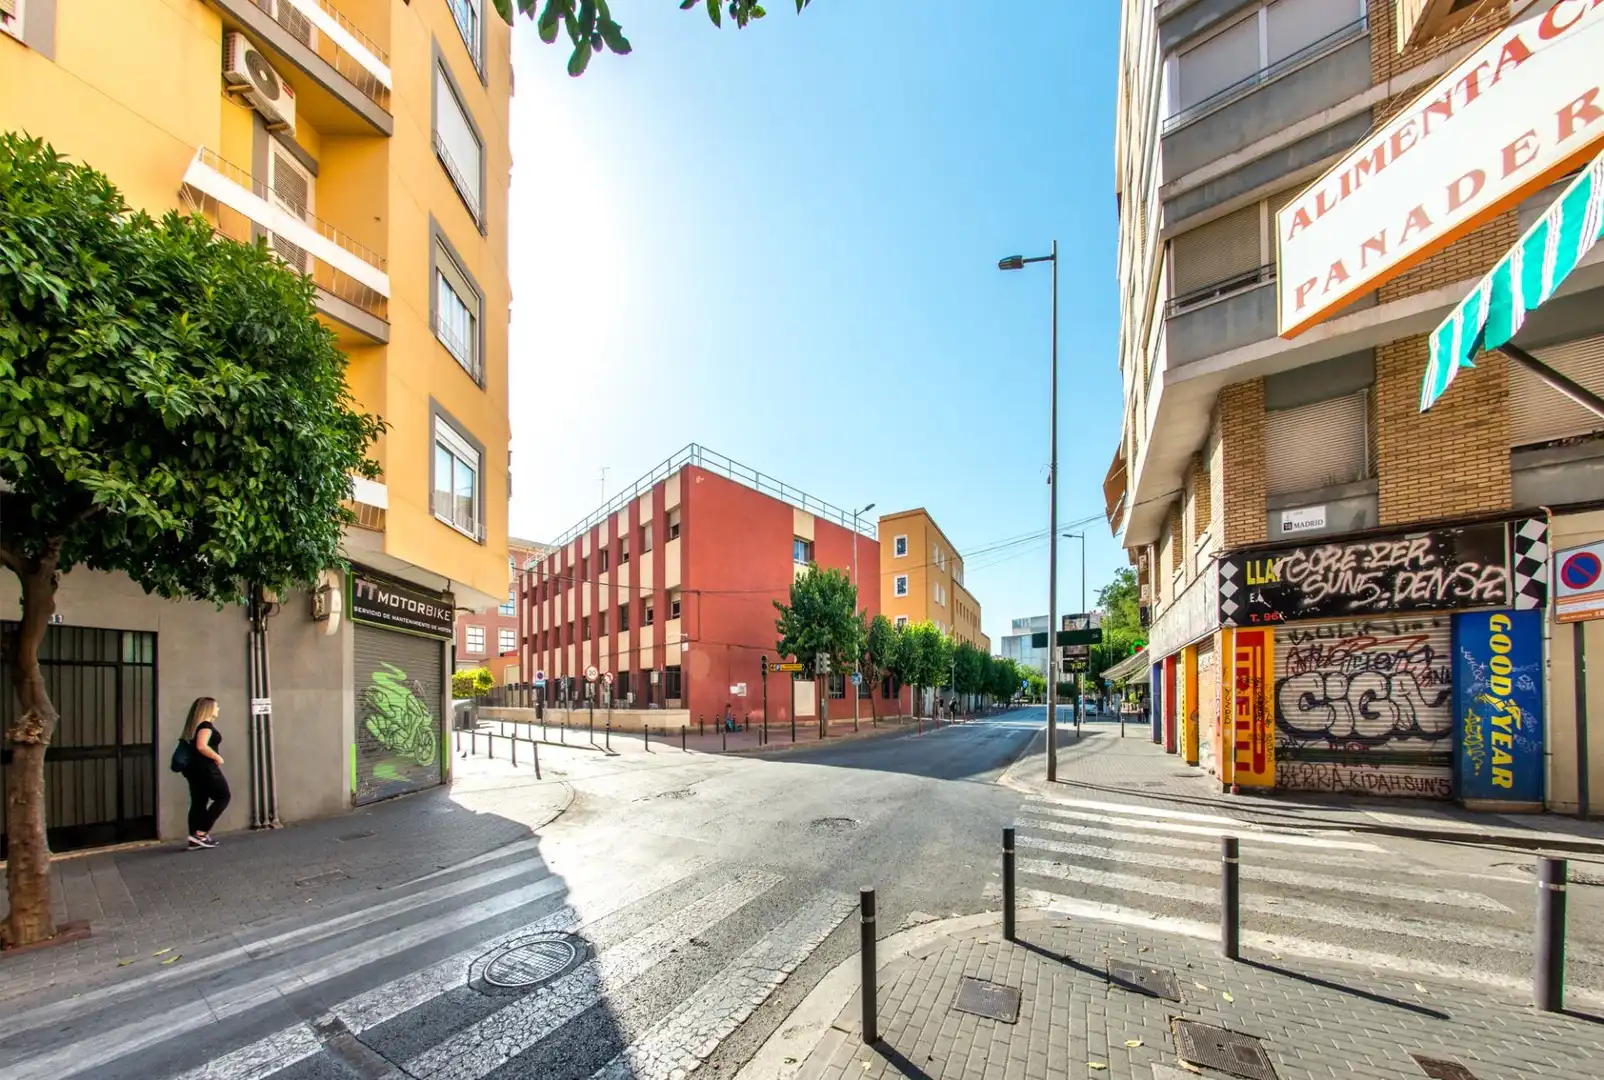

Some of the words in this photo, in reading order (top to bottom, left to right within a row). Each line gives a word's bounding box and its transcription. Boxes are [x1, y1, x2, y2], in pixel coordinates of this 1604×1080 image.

[1288, 0, 1604, 242] ALIMENTAC
[1294, 518, 1324, 529] MADRID
[353, 605, 382, 618] SERVICIO
[382, 612, 390, 620] DE
[391, 614, 431, 629] MANTENIMIENTO
[355, 578, 378, 601] TT
[377, 590, 452, 622] MOTORBIKE
